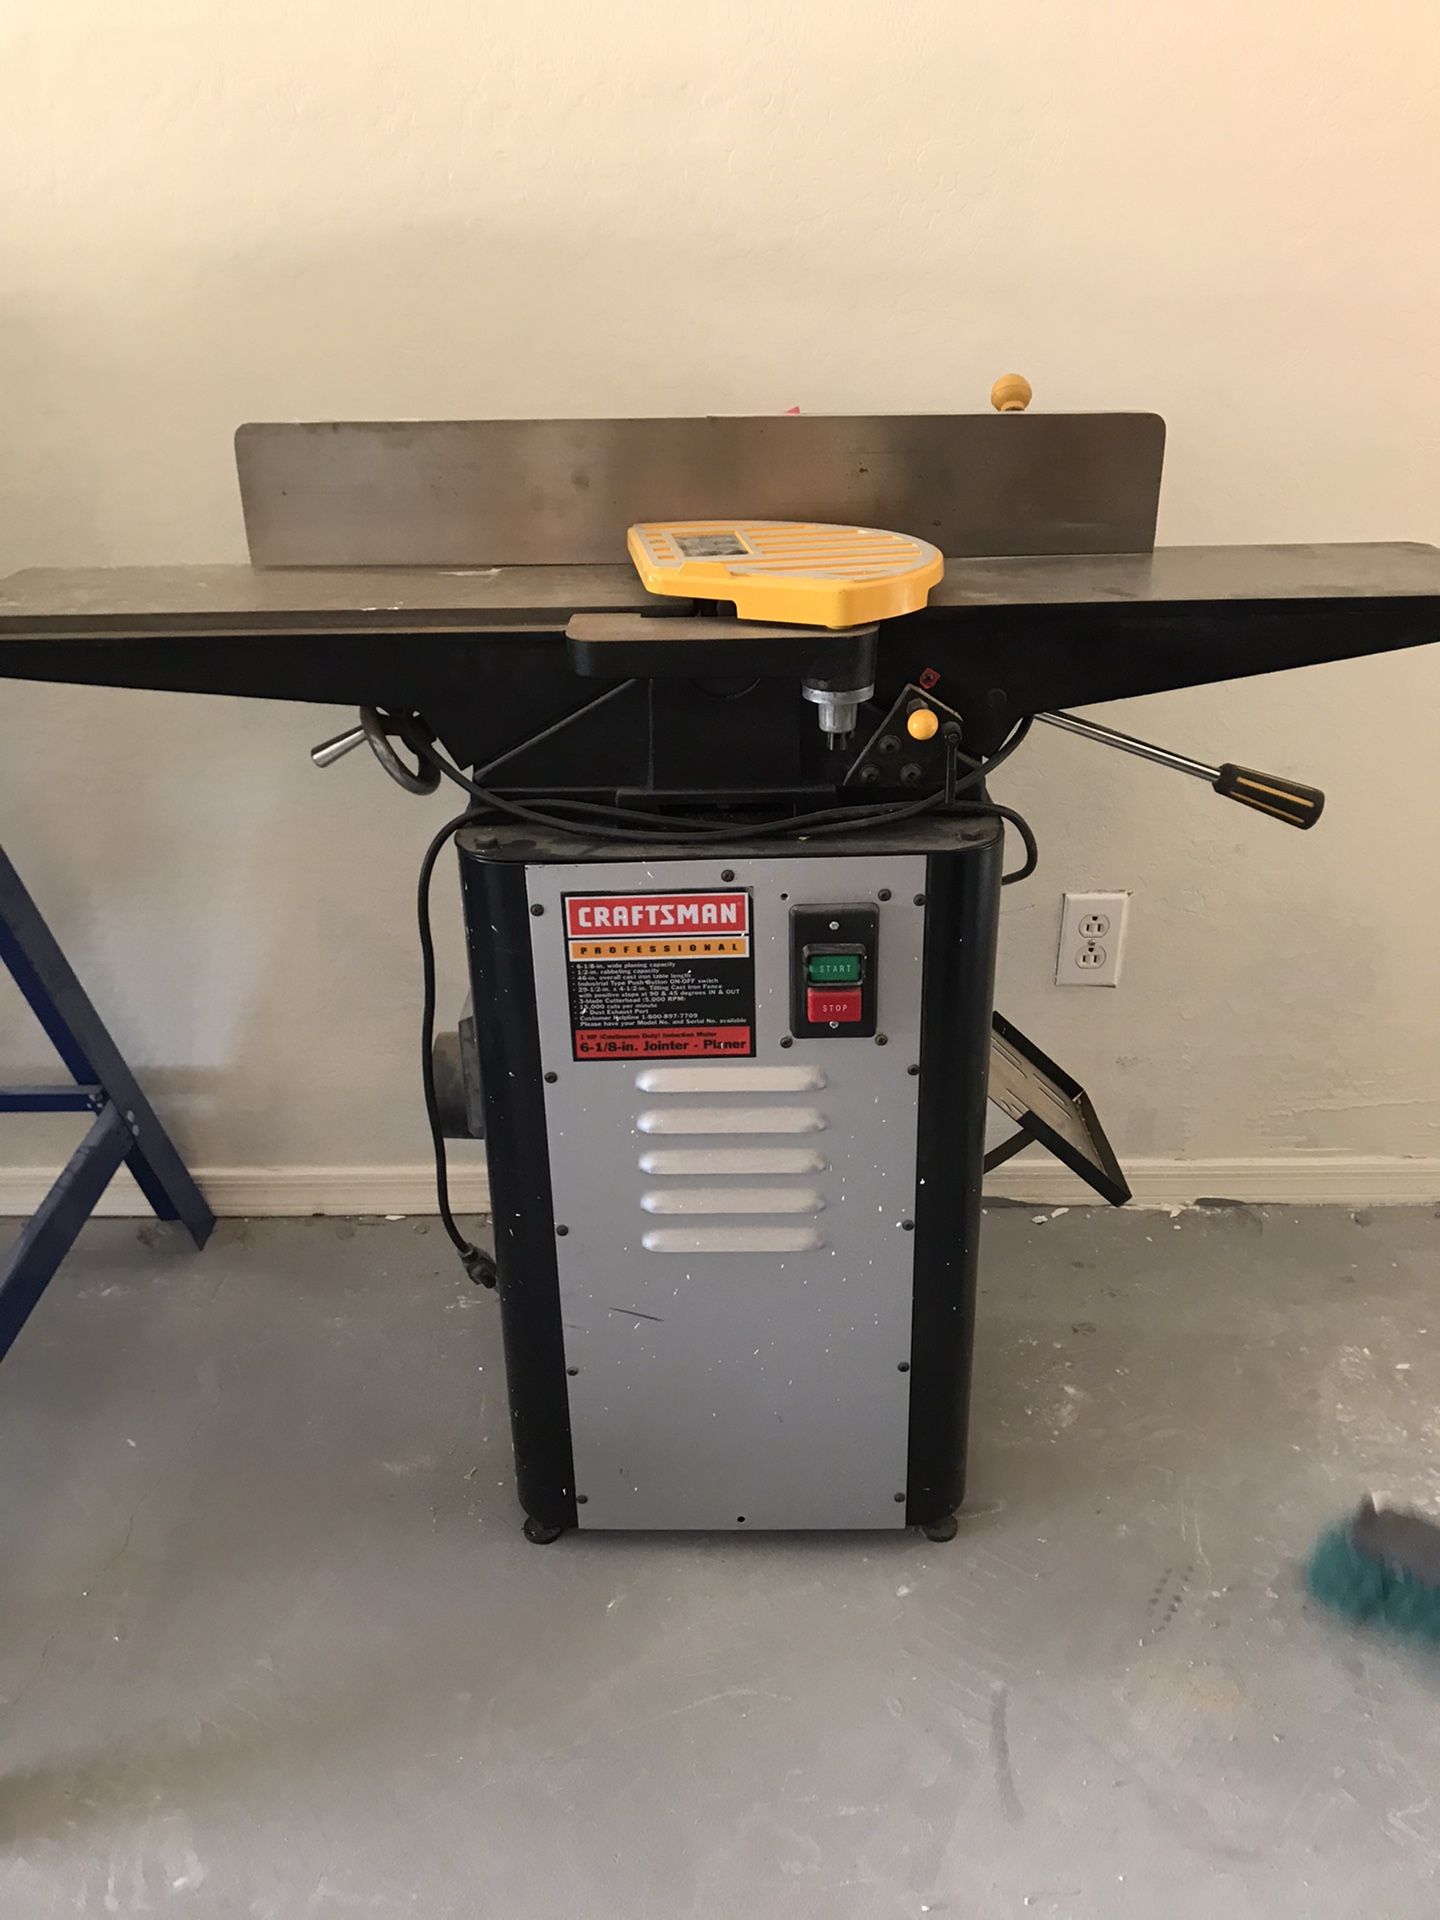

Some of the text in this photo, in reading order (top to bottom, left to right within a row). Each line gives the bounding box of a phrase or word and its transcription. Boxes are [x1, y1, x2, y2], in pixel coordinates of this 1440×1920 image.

[578, 903, 737, 928] CRAFTSMAN
[580, 943, 738, 954] PROFESSIONAL
[820, 964, 851, 973] START
[822, 1004, 848, 1012] STOP
[580, 1041, 638, 1052] 6-1/8-in.
[643, 1040, 689, 1051] Jointer
